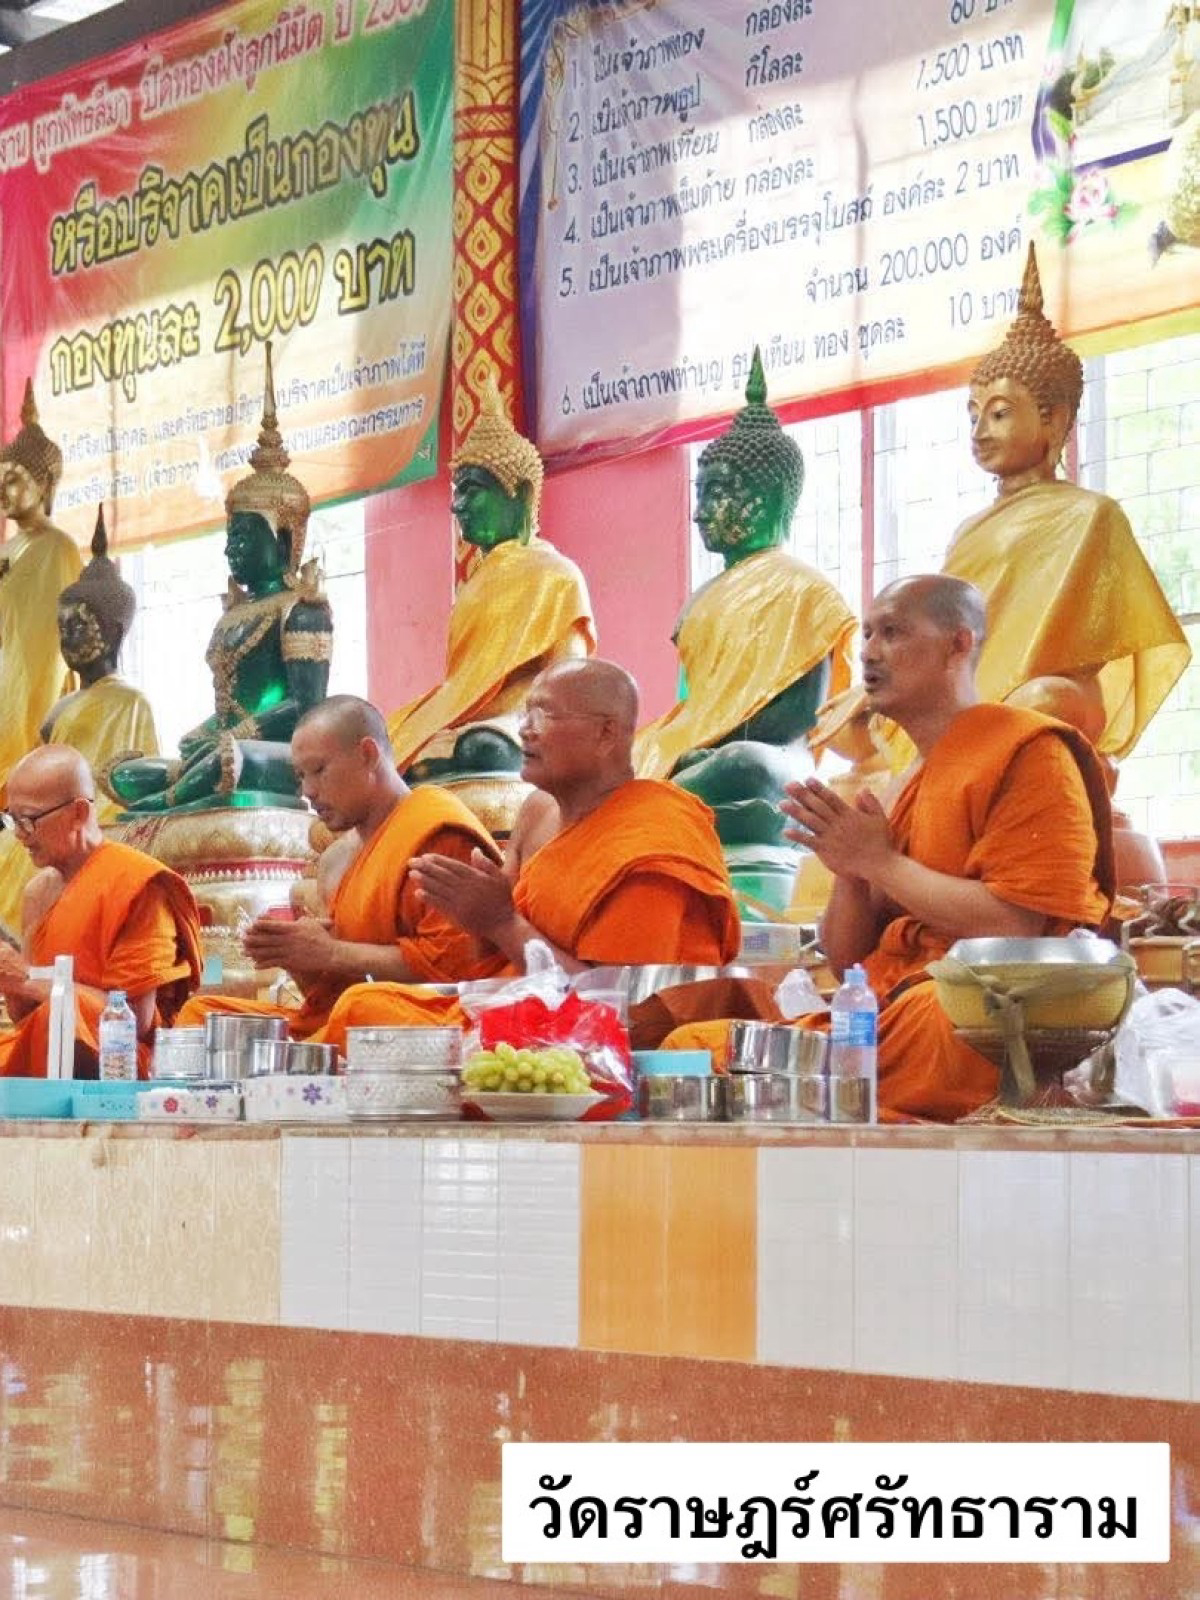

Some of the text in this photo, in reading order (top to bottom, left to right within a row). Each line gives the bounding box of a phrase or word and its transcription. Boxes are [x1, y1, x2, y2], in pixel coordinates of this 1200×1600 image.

[334, 0, 352, 41] ป
[50, 92, 420, 276] หรือบริจาคเป็นกองทุน
[563, 217, 581, 245] 4.
[744, 156, 815, 196] กล่องละ
[917, 99, 977, 148] 1,500
[986, 94, 1023, 129] บาท
[567, 163, 582, 194] 3.
[747, 104, 804, 143] กล่องละ
[916, 42, 970, 90] 1,500
[979, 34, 1025, 70] บาท
[567, 111, 584, 142] 2.
[559, 267, 576, 298] 5.
[882, 169, 946, 217] องค์ละ
[954, 161, 969, 195] 2
[977, 153, 1020, 189] บาท
[805, 266, 869, 303] จำนวน
[980, 212, 1022, 261] องค์
[49, 228, 416, 401] กองทุนละ 2,000 บาท
[561, 384, 576, 416] 6.
[581, 355, 724, 411] เป็นเจ้าภาพทำบุญ
[814, 329, 849, 361] ทอง
[857, 317, 905, 361] ชุดละ
[949, 291, 973, 329] 10
